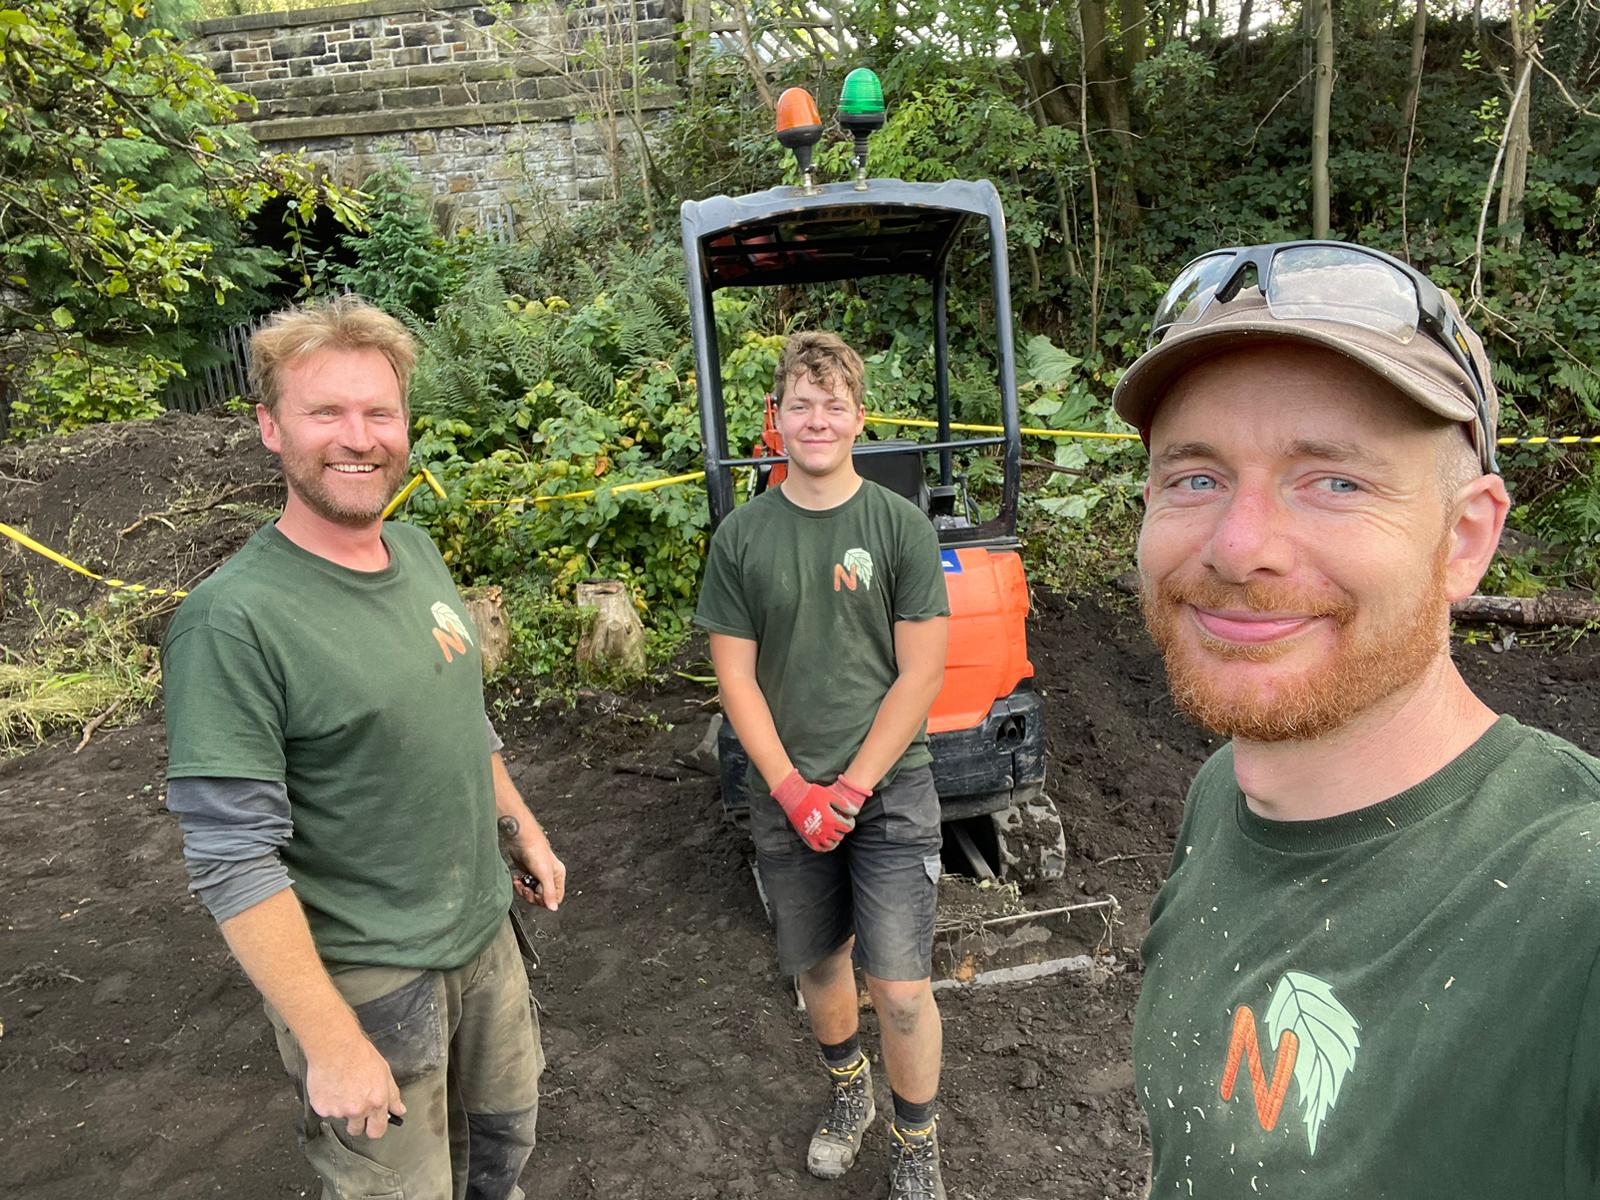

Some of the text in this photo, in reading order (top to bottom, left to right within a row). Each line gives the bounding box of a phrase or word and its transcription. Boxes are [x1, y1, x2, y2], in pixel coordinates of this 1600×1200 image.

[833, 563, 857, 592] N
[431, 622, 466, 664] N
[1220, 1004, 1300, 1132] N
